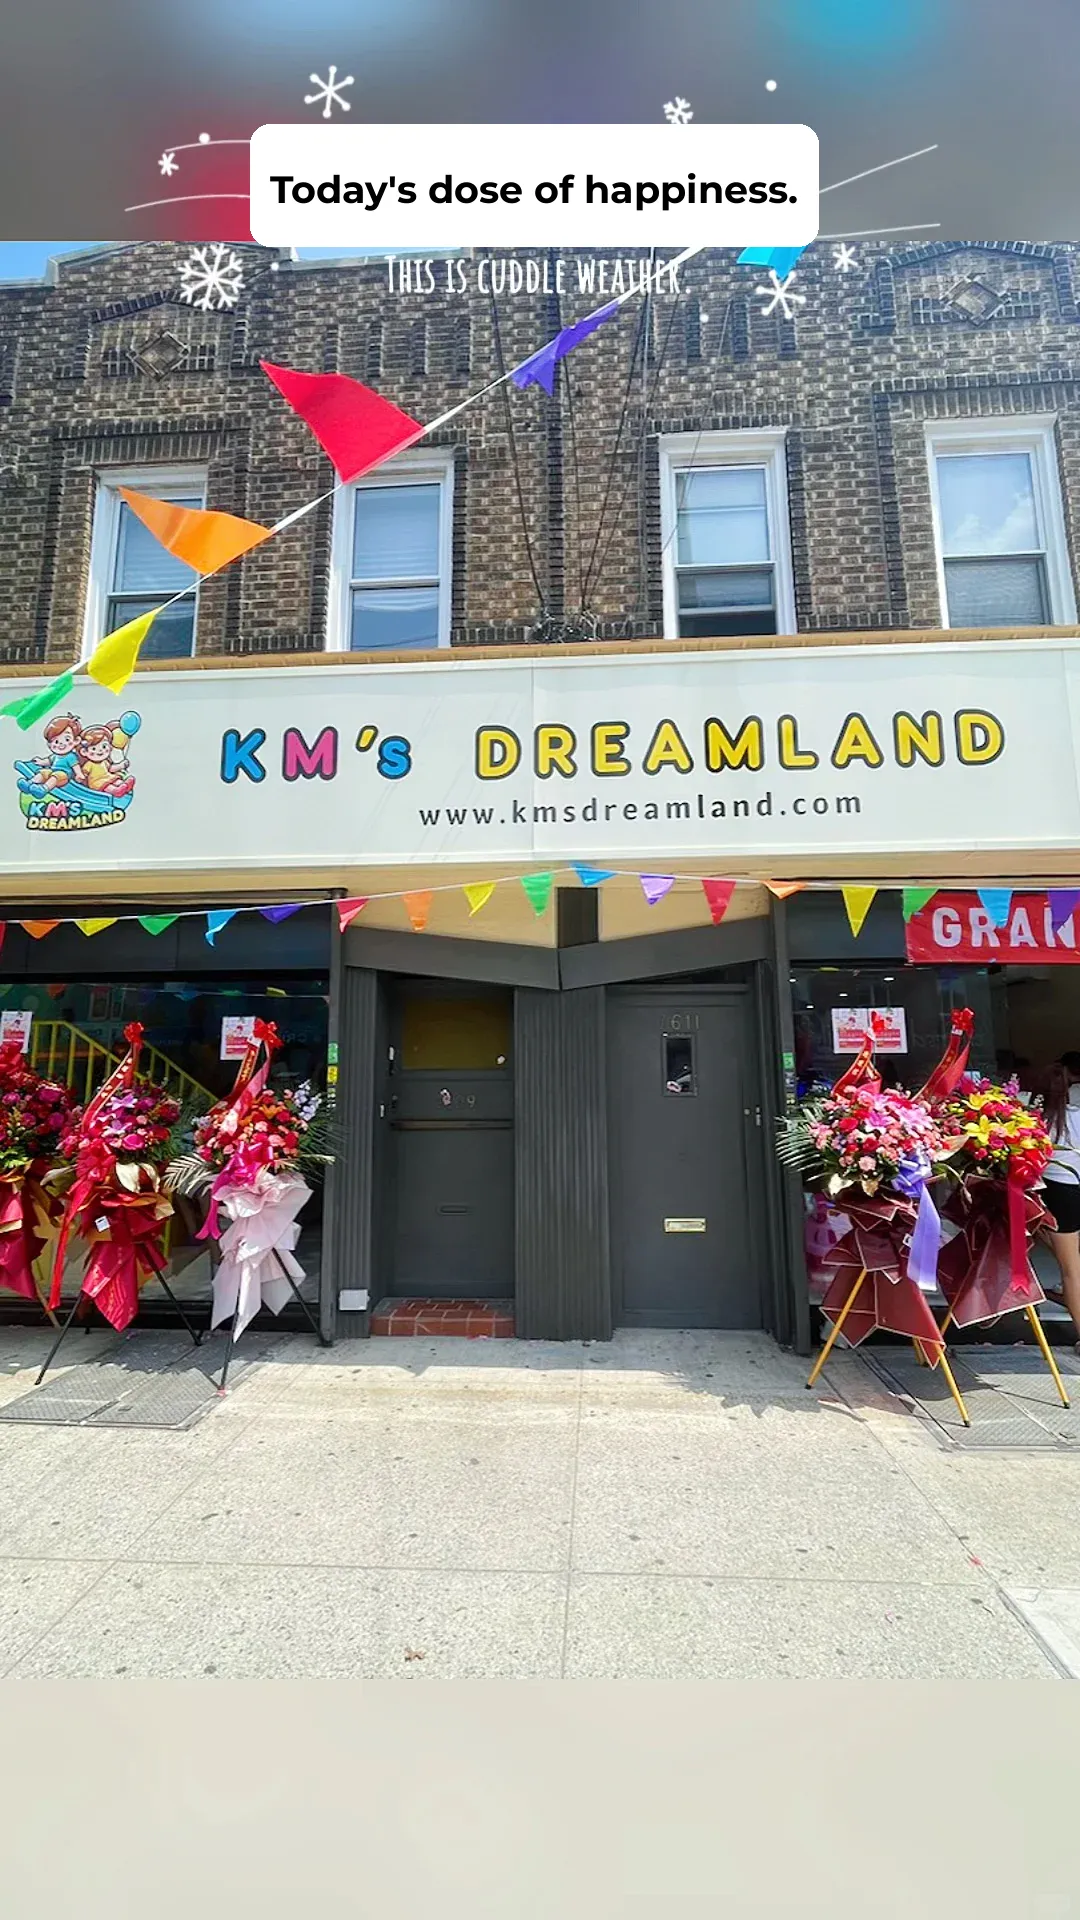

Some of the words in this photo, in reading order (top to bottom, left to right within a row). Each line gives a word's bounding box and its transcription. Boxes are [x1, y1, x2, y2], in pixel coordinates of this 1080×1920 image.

[220, 725, 413, 783] KM's
[474, 708, 1005, 780] DREAMLAND
[27, 809, 125, 830] DREAMLAND
[418, 792, 862, 826] www.kmsdreamland.com
